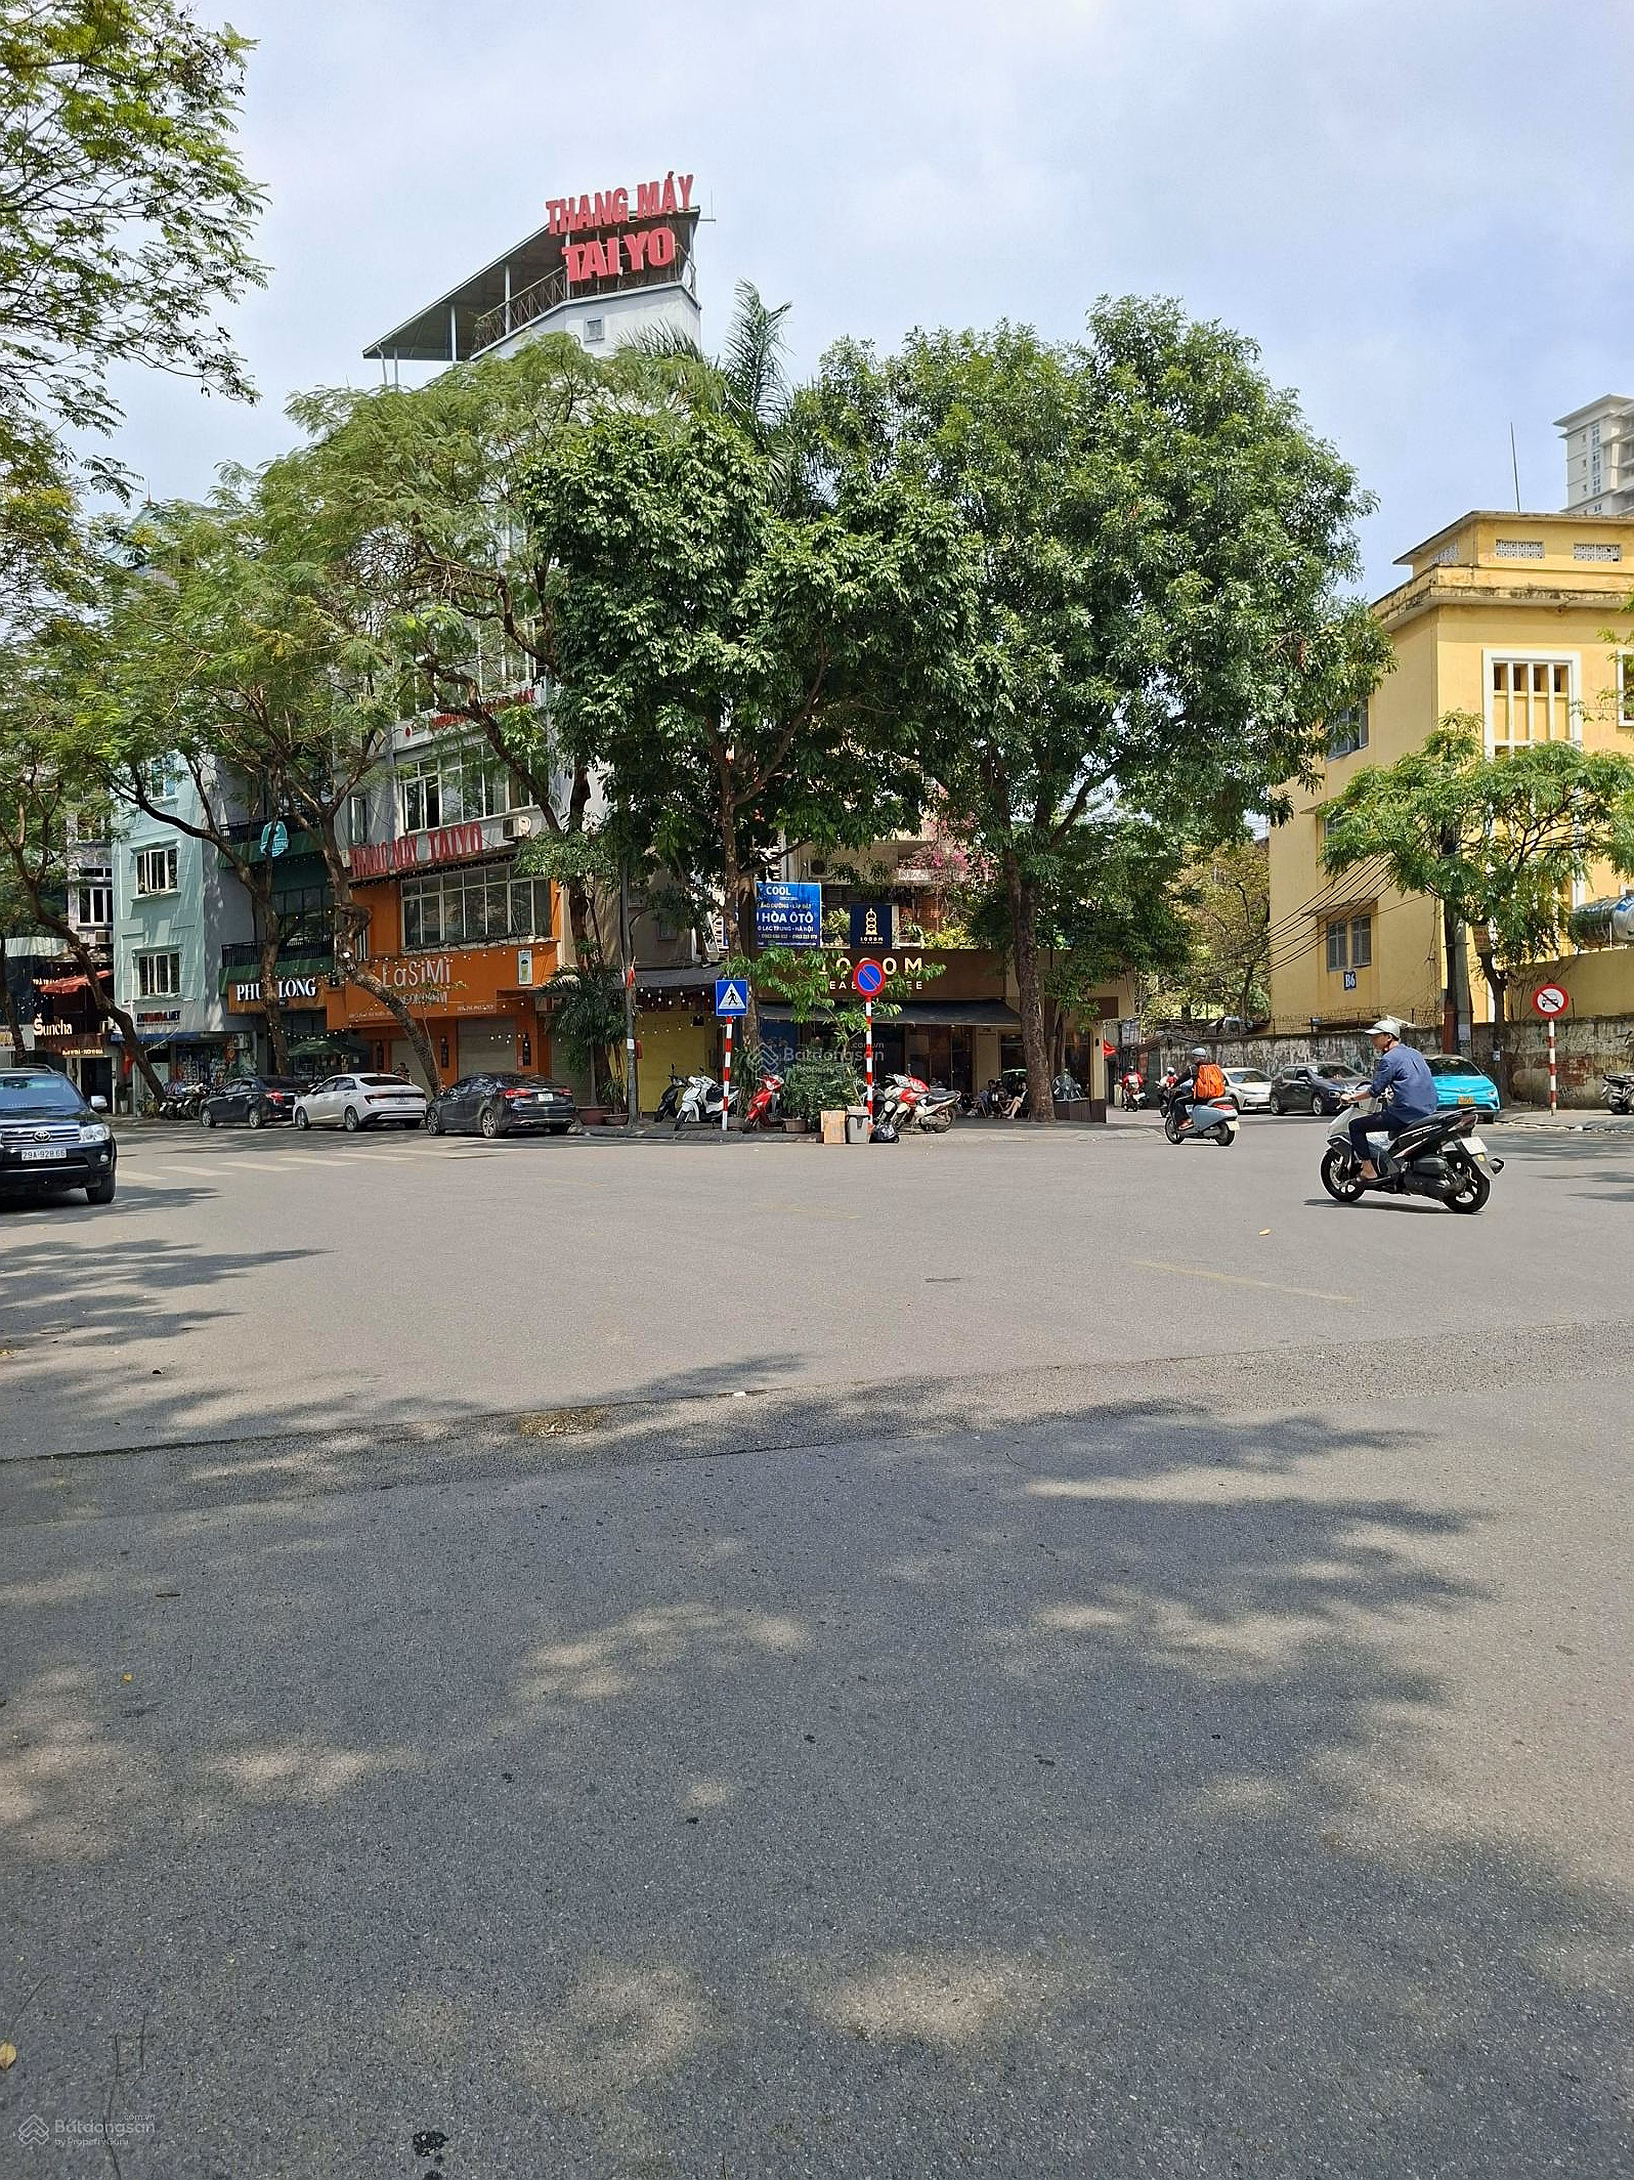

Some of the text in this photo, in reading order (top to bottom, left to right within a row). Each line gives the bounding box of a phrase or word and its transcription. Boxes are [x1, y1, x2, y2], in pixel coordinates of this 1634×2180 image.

[546, 171, 694, 235] THANG MÁY
[562, 227, 675, 282] TAIYO
[428, 821, 482, 863] TAIYO
[766, 886, 791, 896] COOL
[762, 911, 787, 923] HÒA
[278, 978, 316, 998] LONG
[1345, 974, 1356, 988] B6
